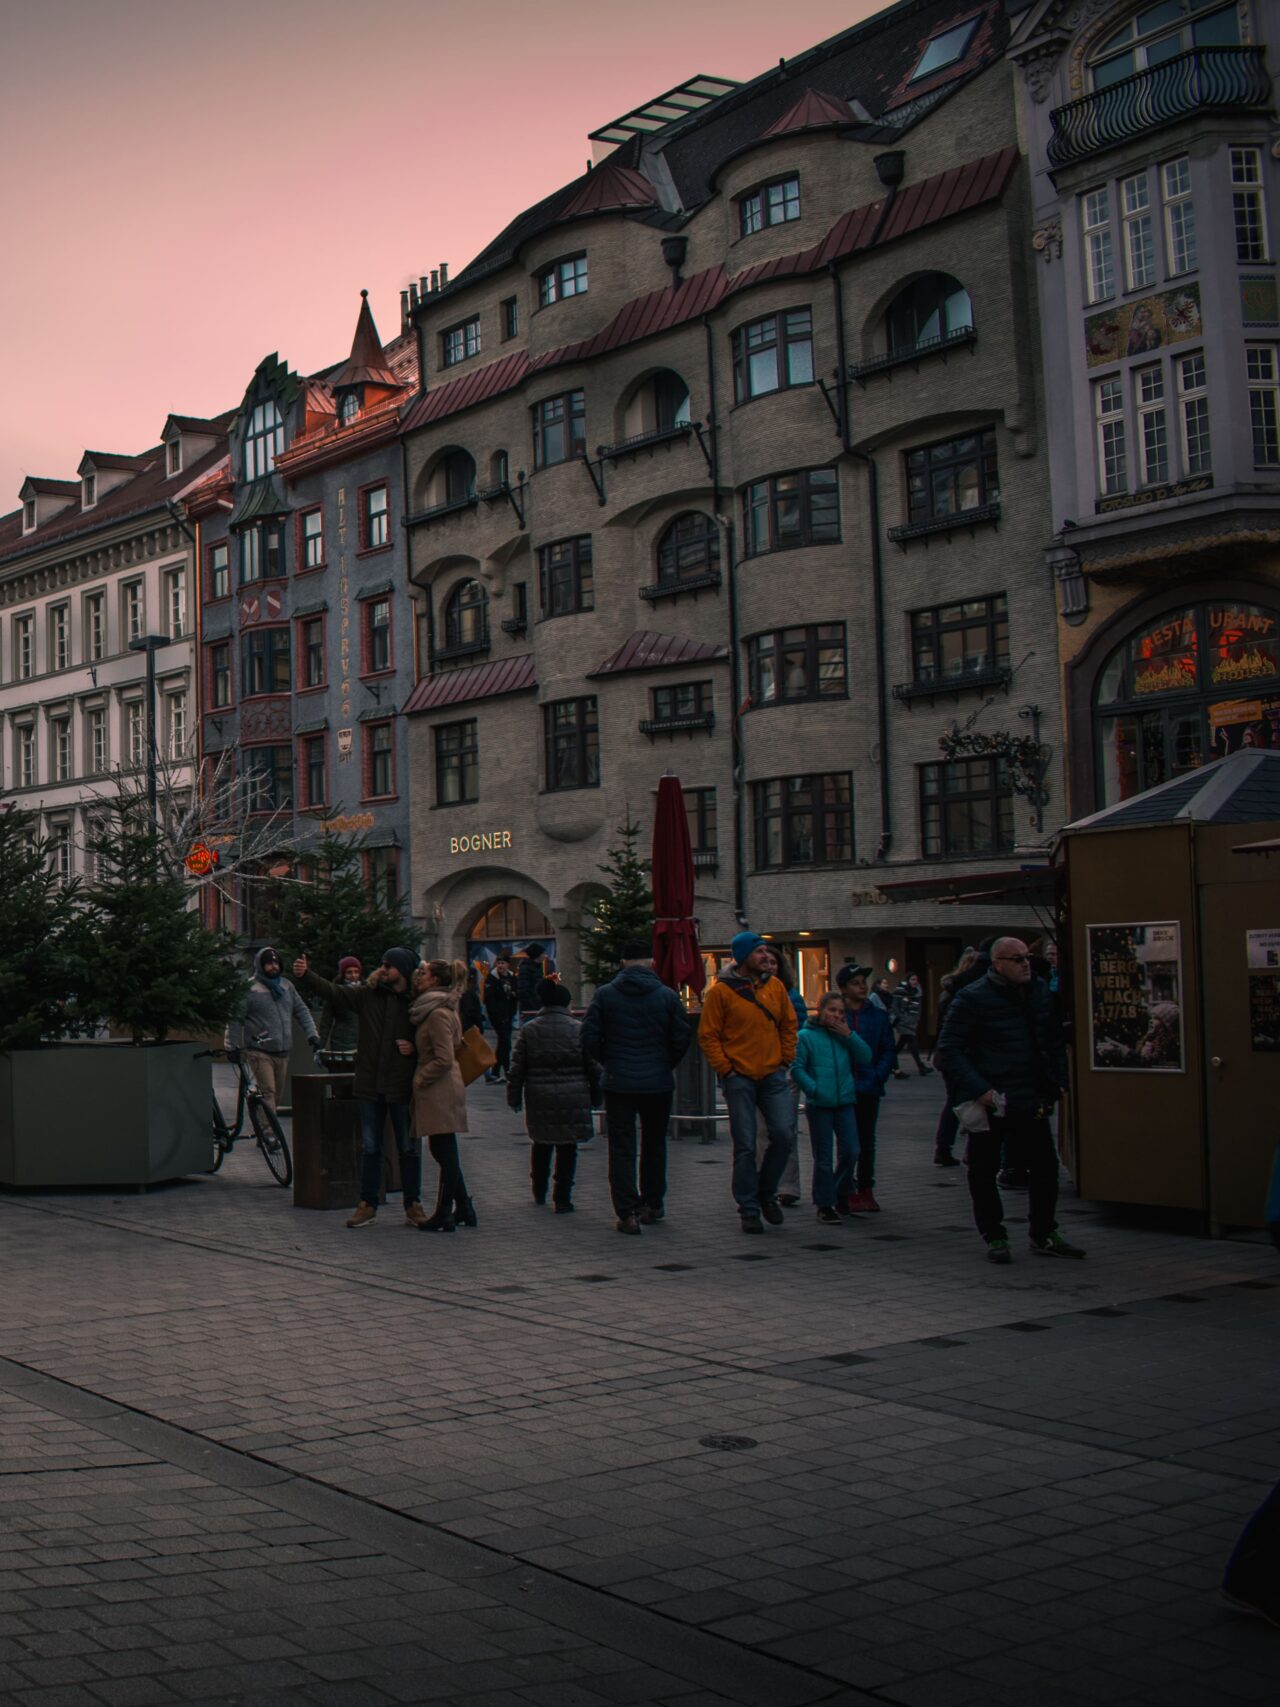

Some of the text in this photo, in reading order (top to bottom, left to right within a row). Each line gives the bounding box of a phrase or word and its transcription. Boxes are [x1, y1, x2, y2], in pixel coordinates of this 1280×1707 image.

[450, 831, 512, 854] BOGNER
[1099, 960, 1136, 974] BERG
[1094, 976, 1130, 989] WEIH
[1098, 1005, 1137, 1019] 17/18
